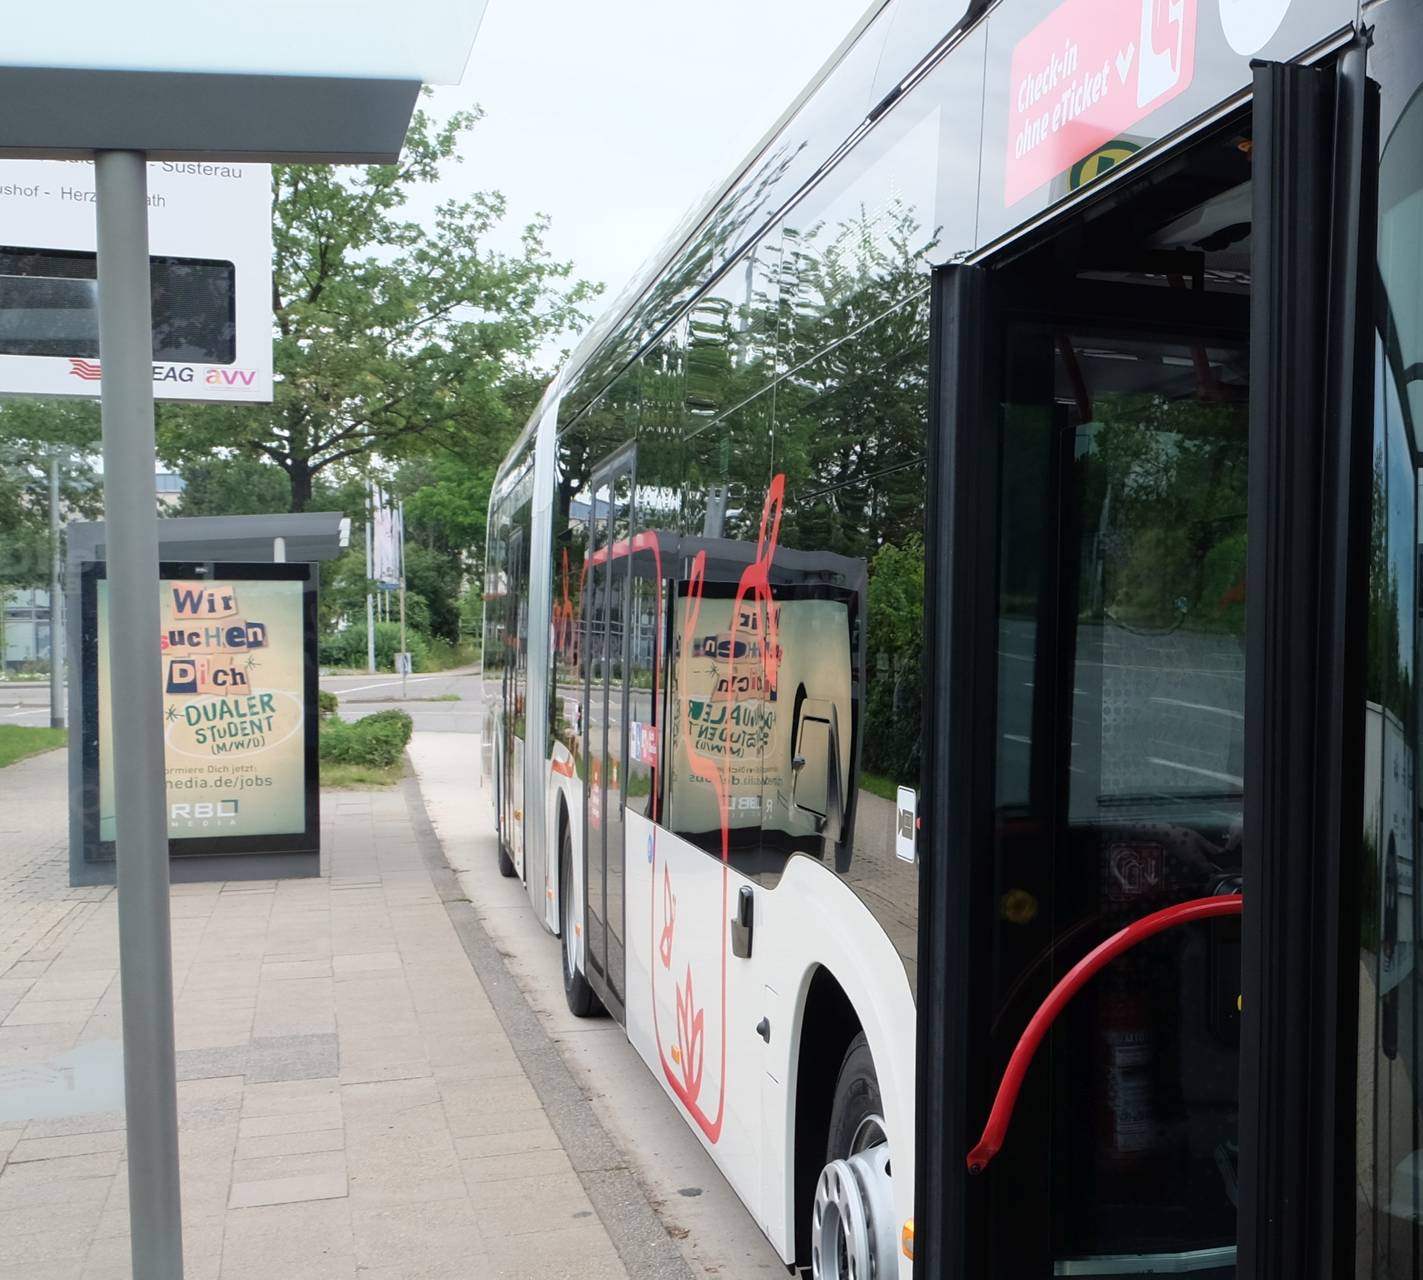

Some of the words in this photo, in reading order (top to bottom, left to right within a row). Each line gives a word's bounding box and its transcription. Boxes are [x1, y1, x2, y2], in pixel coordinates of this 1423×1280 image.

[1018, 39, 1078, 113] Check-in
[1016, 112, 1049, 160] ohne
[1052, 60, 1110, 132] eTicket
[162, 160, 243, 178] Susterau
[152, 366, 194, 382] EAG
[206, 369, 256, 385] avv
[173, 588, 233, 614] Wir
[172, 662, 248, 687] Dich
[185, 693, 276, 726] DUALER
[211, 736, 266, 755] (M/W/D)
[165, 766, 204, 775] ormiere
[207, 765, 229, 774] Dich
